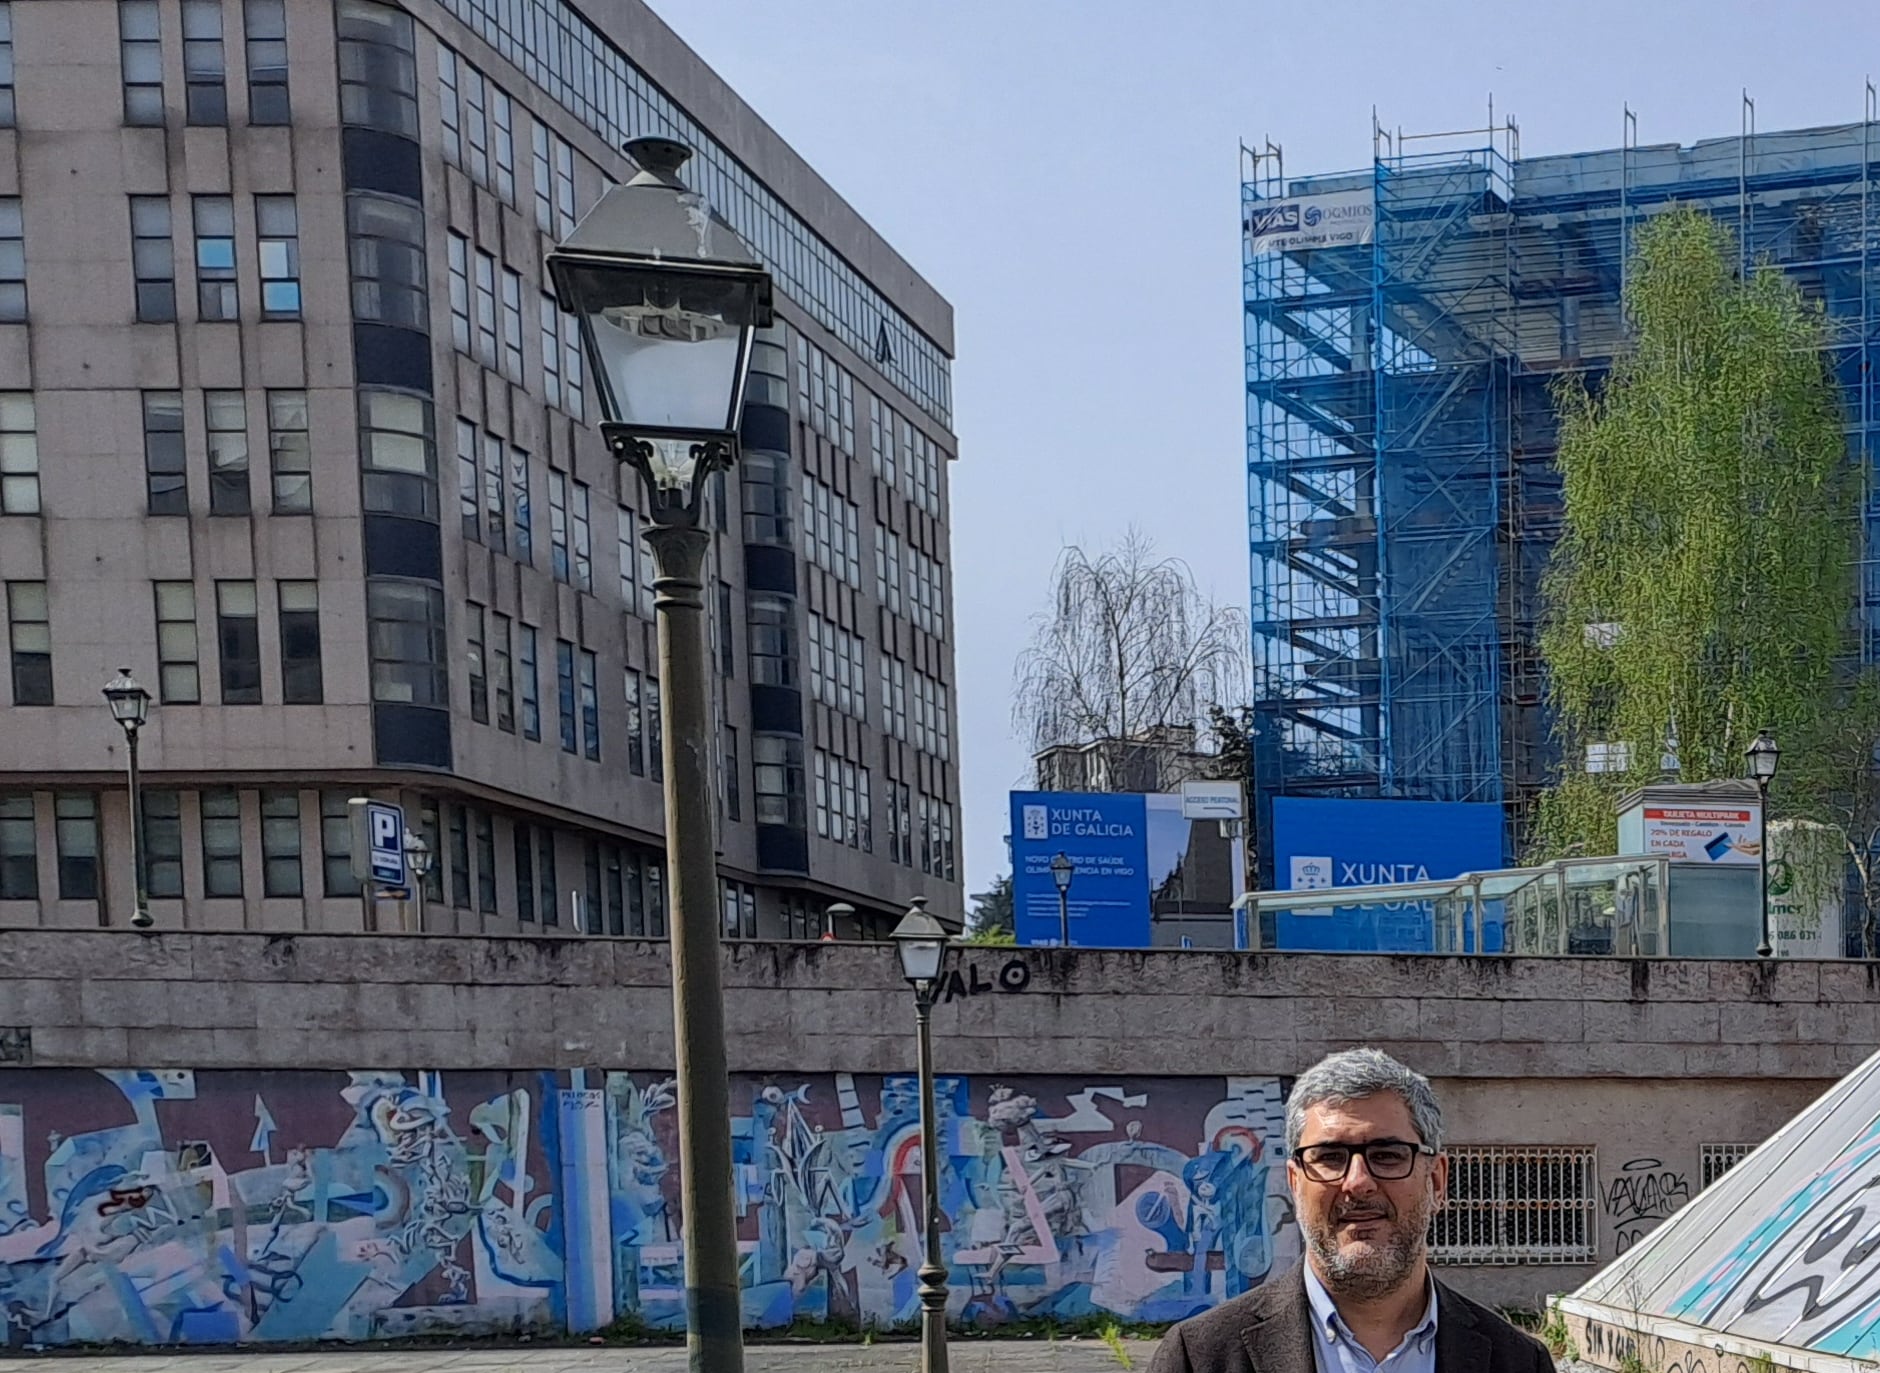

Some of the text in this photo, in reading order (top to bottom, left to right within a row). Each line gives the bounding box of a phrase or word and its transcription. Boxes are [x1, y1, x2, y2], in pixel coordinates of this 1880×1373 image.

[1322, 204, 1373, 220] OGMIOS
[1329, 231, 1353, 242] VIGO
[1051, 808, 1102, 821] XUNTA
[373, 812, 396, 848] P
[1052, 823, 1134, 837] DE GALICIA
[1051, 856, 1084, 864] CTRO
[1340, 863, 1430, 884] XUNTA
